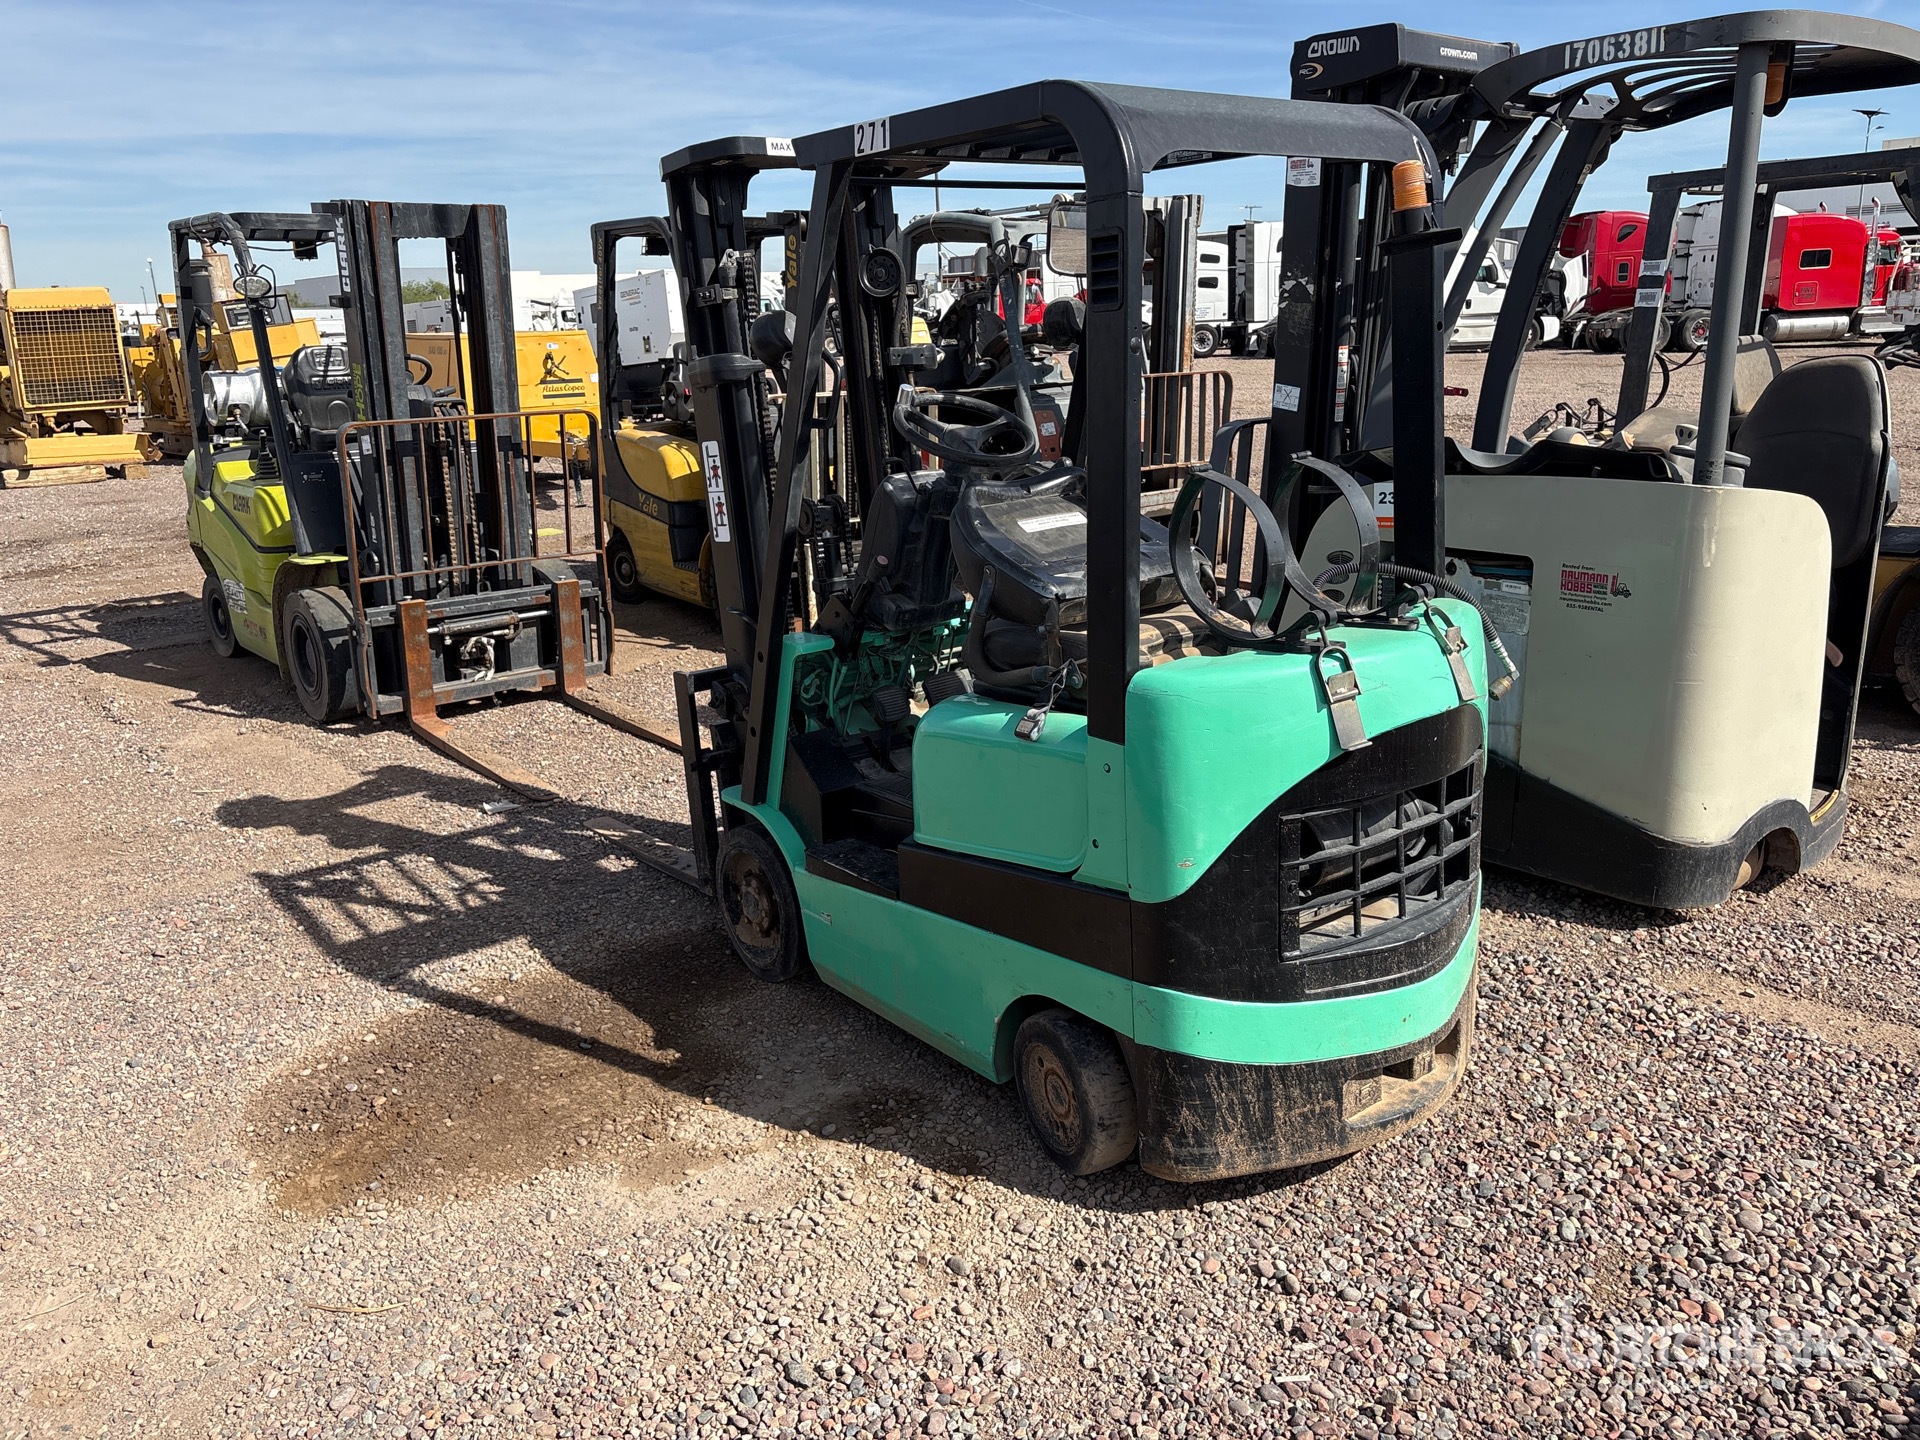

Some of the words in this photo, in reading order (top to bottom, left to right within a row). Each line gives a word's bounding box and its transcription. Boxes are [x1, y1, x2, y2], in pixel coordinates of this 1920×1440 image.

[1307, 35, 1360, 58] CROWN
[1439, 46, 1478, 61] crown.com
[857, 119, 887, 154] 271
[770, 142, 792, 151] MAX
[335, 217, 351, 293] CLARK
[786, 234, 798, 289] Yale
[118, 308, 125, 317] 2
[354, 364, 366, 422] HOPE
[542, 384, 563, 393] Atlas
[563, 384, 586, 392] Copco
[232, 493, 251, 515] CLARK
[638, 492, 658, 516] Yale
[1561, 569, 1609, 584] NAUMANN
[1560, 580, 1593, 594] HOBBS
[1559, 597, 1613, 607] naumannhobbs.com
[1565, 603, 1605, 613] 855-95RENTAL
